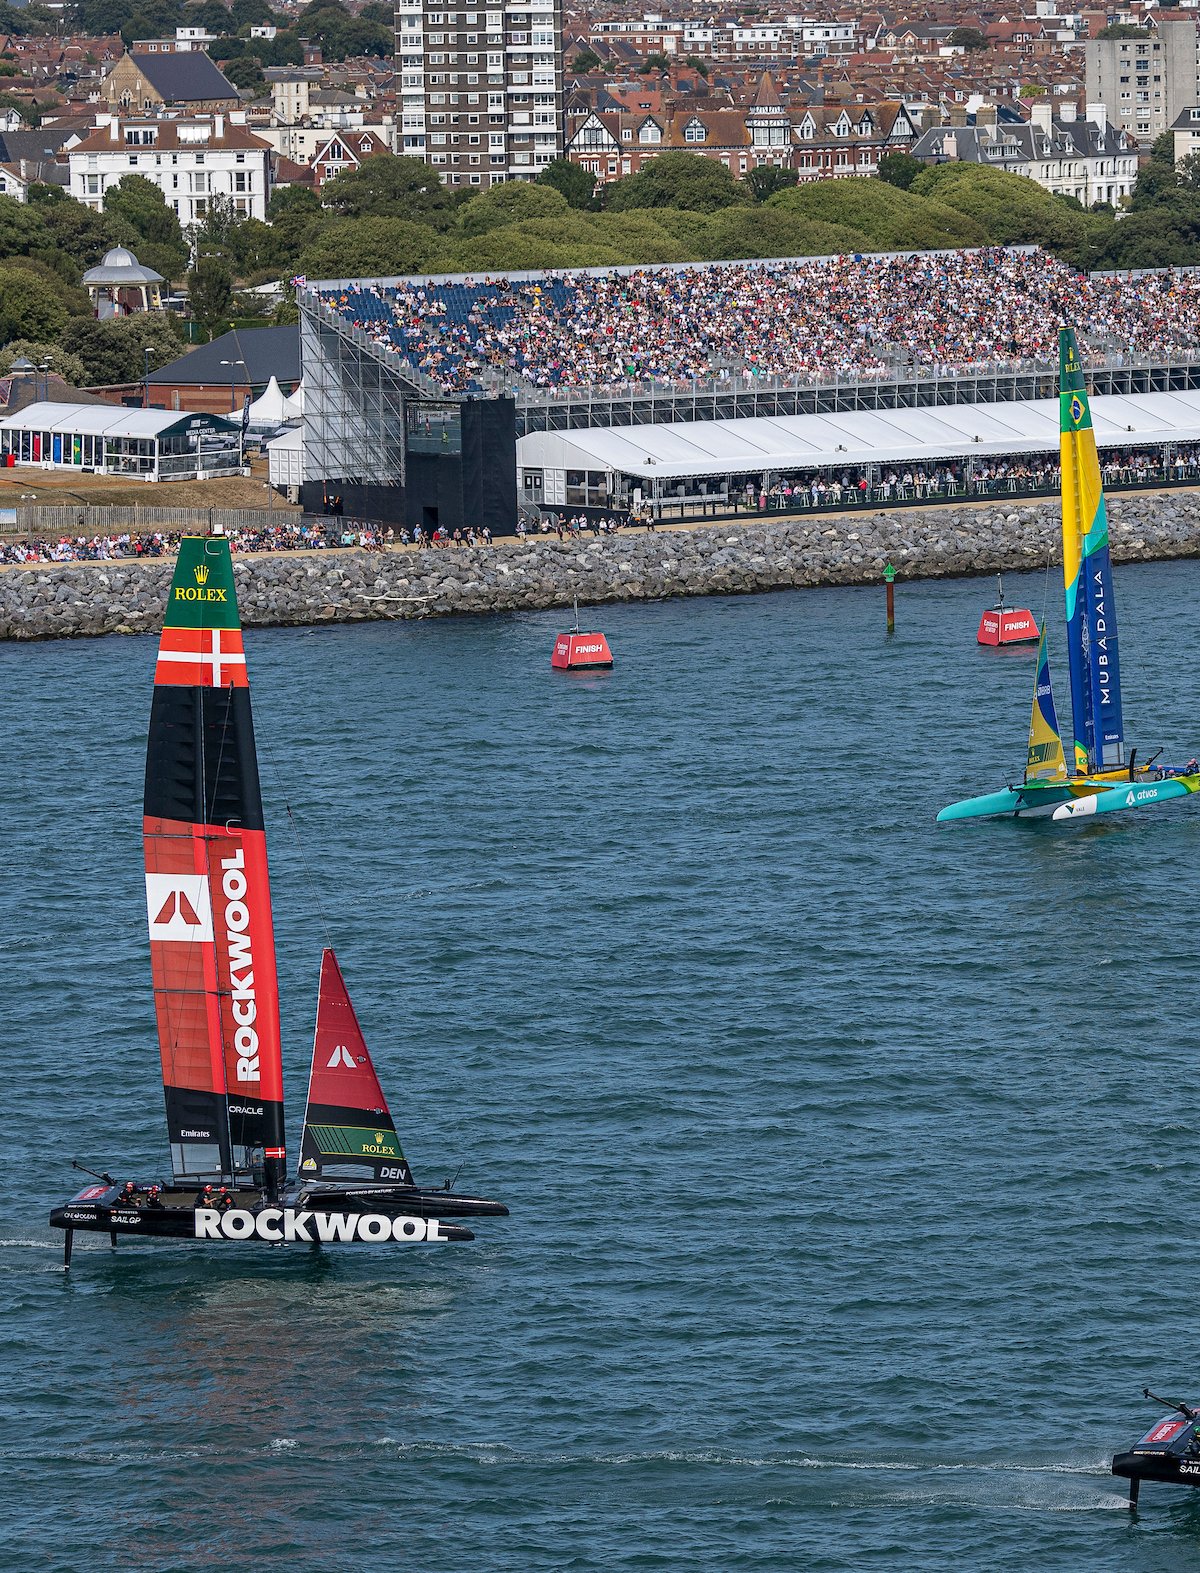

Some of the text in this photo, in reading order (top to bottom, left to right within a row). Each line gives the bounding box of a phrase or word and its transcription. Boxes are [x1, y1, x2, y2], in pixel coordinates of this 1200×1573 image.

[175, 587, 227, 602] ROLEX
[1004, 620, 1030, 631] FINISH
[1094, 571, 1111, 704] MUBADALA
[575, 644, 603, 654] FINISH
[1137, 789, 1157, 800] atvos
[221, 848, 260, 1082] ROCKWOOL
[228, 1105, 263, 1115] ORACLE
[180, 1129, 210, 1138] Emirates
[361, 1144, 395, 1155] ROLEX
[380, 1166, 406, 1180] DEN
[194, 1208, 449, 1242] ROCKWOOL
